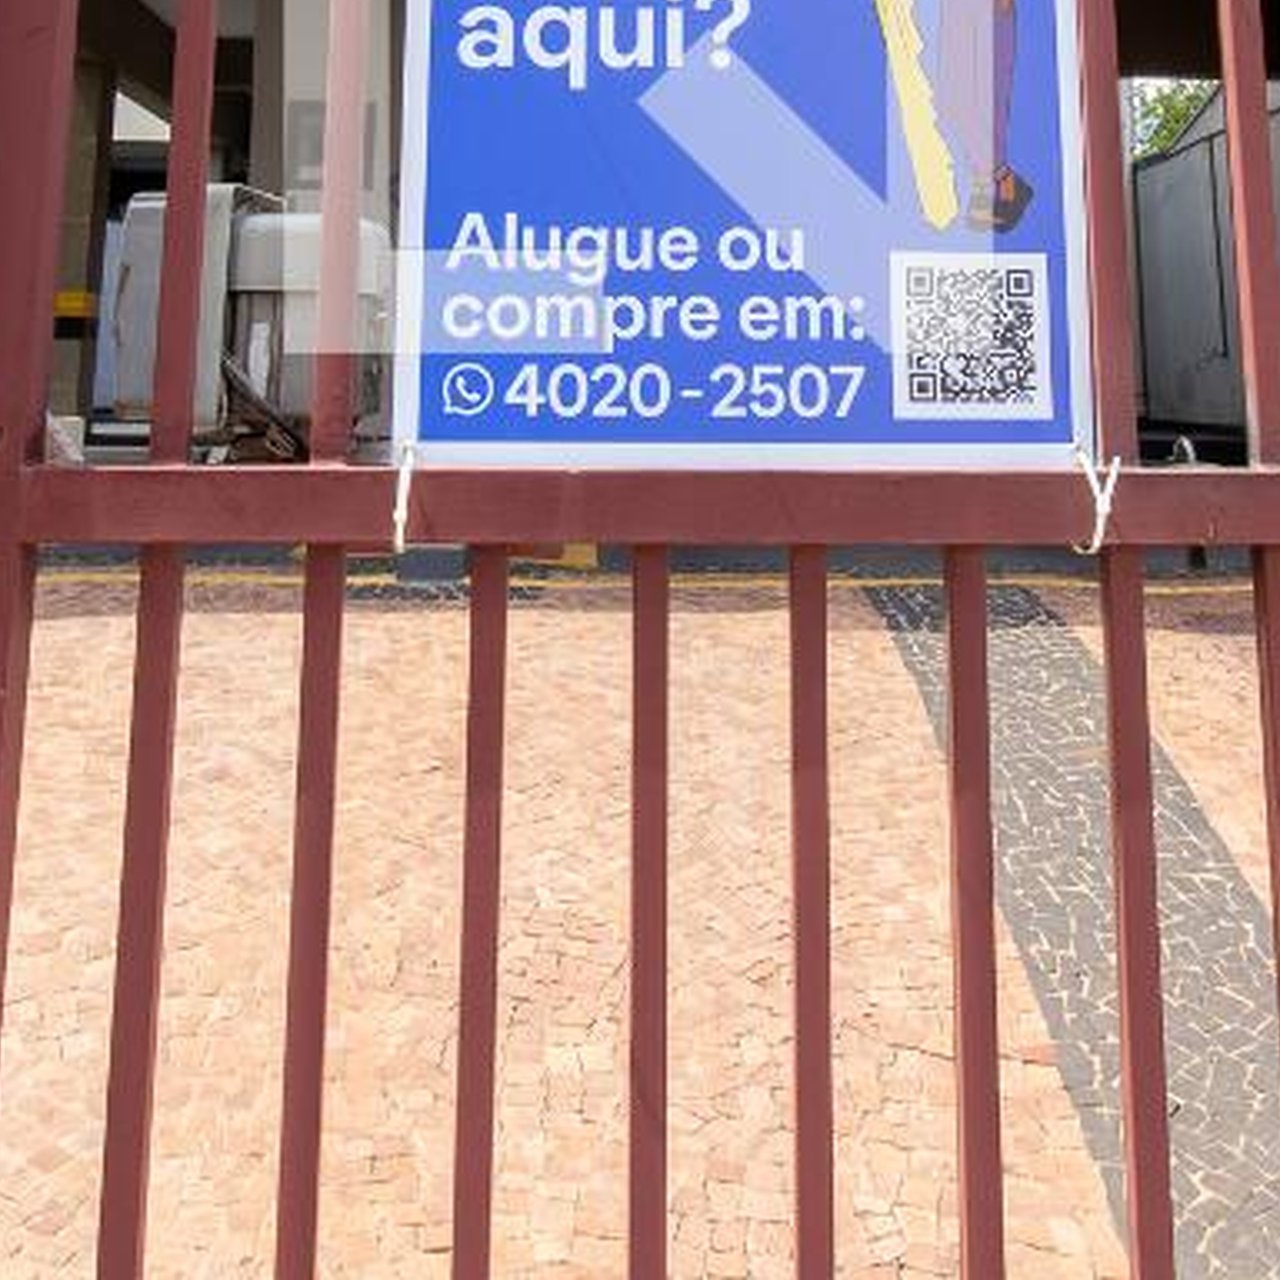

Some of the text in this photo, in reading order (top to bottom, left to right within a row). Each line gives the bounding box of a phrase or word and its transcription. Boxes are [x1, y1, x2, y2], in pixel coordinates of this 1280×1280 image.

[444, 212, 806, 285] Alugue ou
[441, 291, 866, 355] compre em:
[502, 362, 867, 419] 4020-2507
